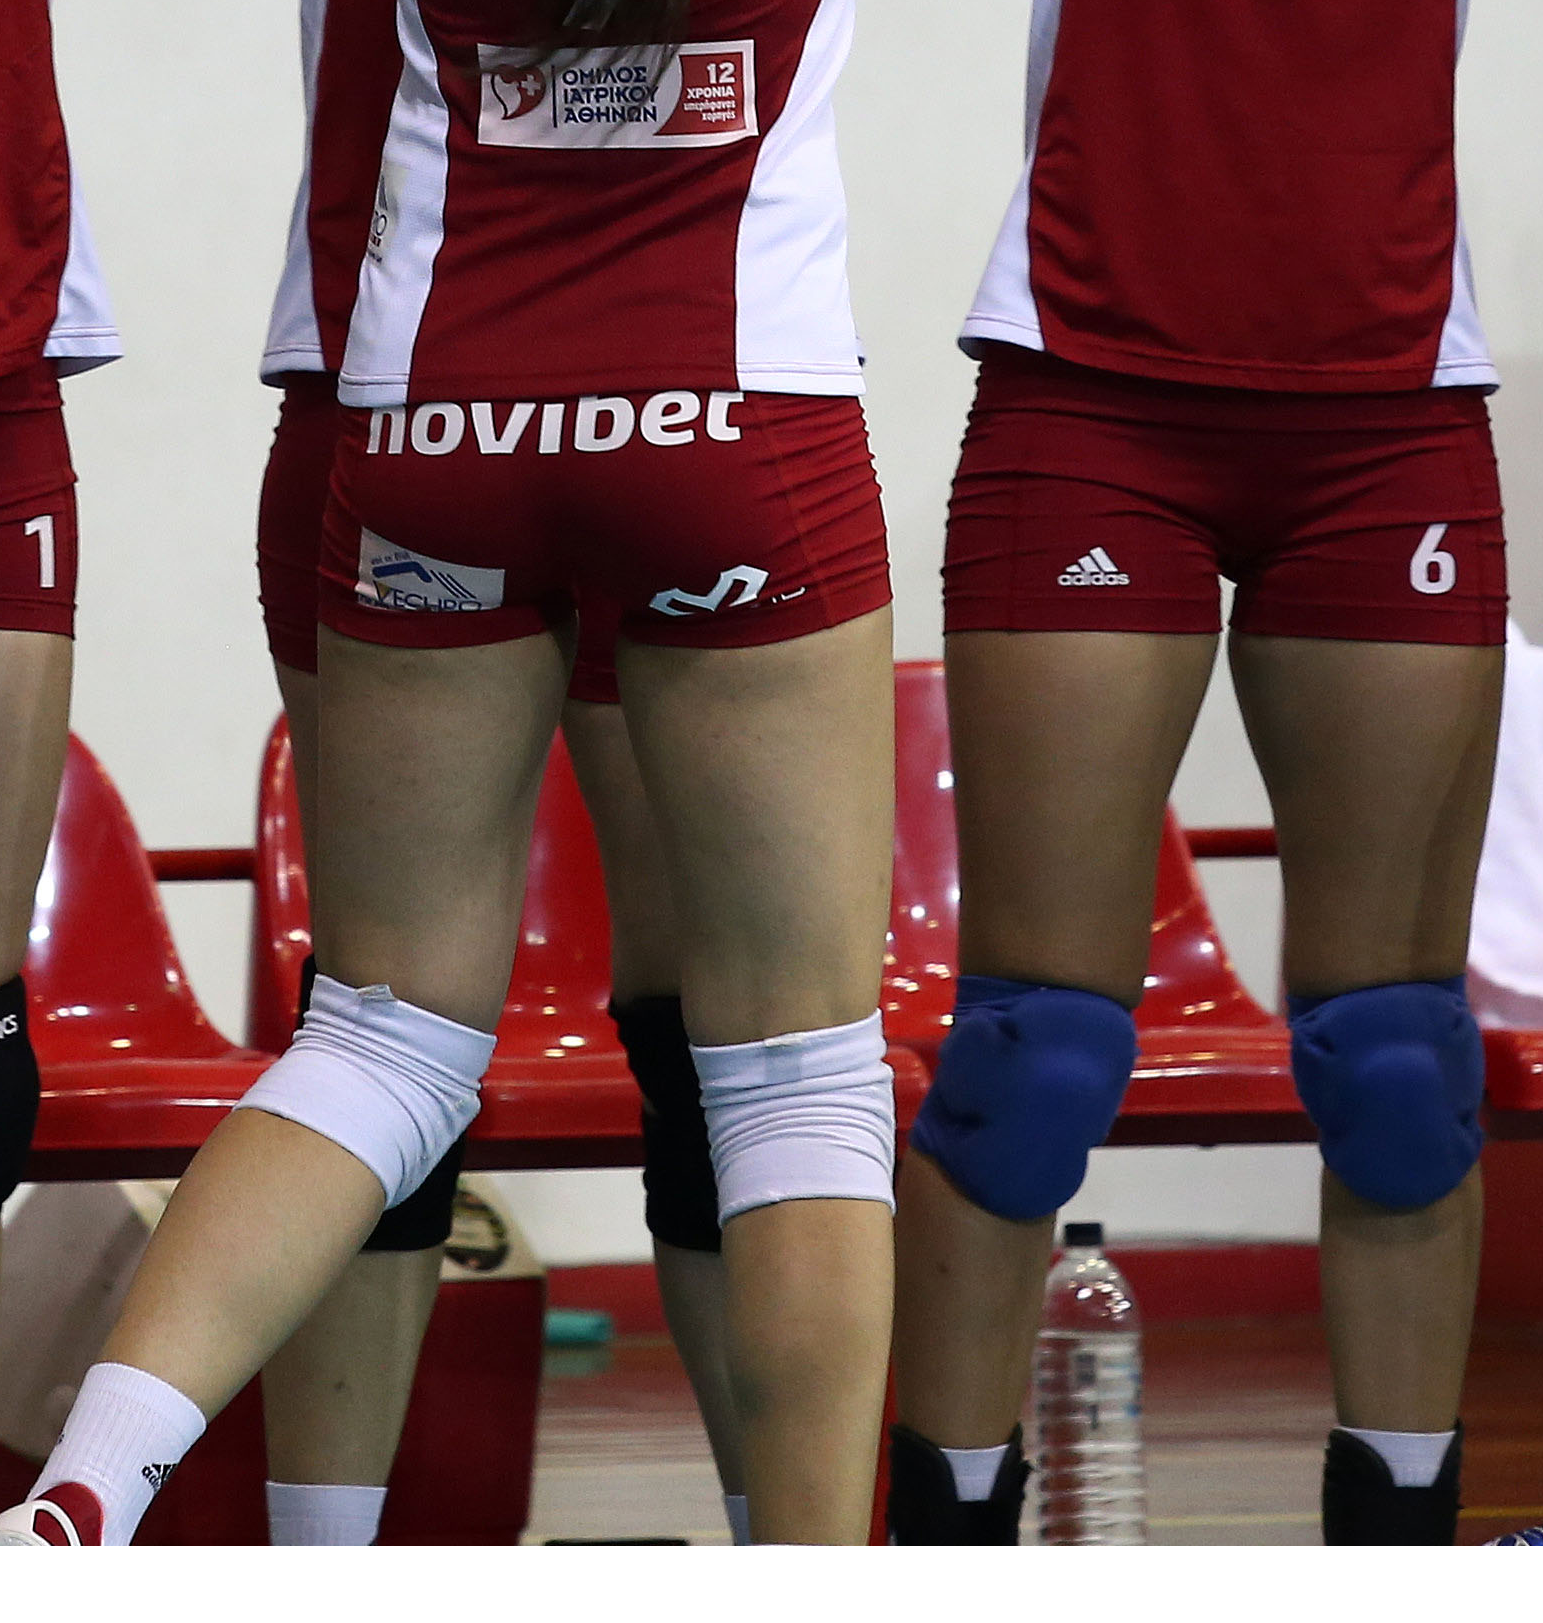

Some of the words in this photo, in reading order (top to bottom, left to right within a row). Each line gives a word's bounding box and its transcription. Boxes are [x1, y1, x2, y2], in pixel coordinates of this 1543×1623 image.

[706, 61, 736, 84] 12
[24, 514, 55, 588] 1
[1409, 522, 1456, 594] 6
[1057, 571, 1130, 586] adidas
